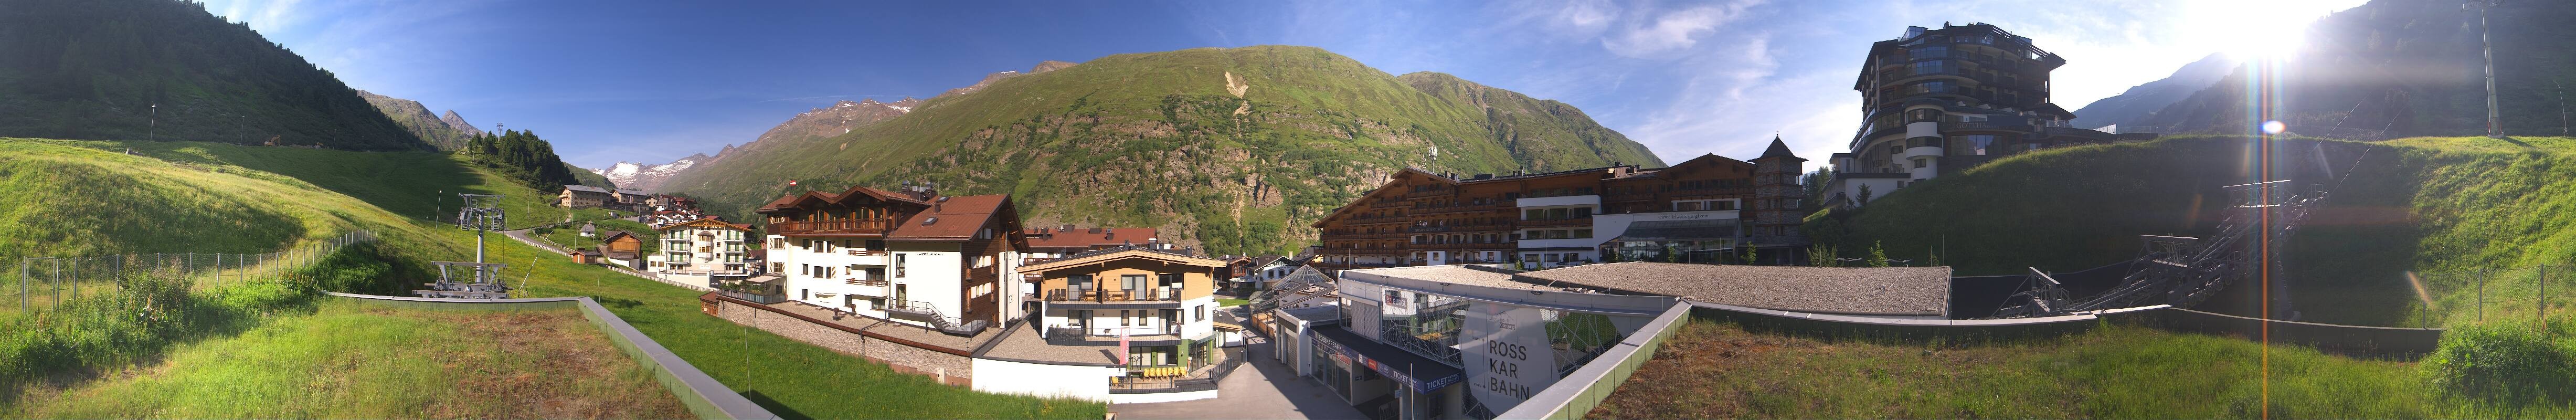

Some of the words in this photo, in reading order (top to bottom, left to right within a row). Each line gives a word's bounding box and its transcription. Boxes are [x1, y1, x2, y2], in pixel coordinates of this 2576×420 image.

[1393, 298, 1407, 307] GURGL
[1319, 334, 1342, 352] ROSSKARBAHN
[1490, 340, 1526, 361] ROSS
[1393, 371, 1409, 383] TICKET
[1490, 358, 1518, 379] KAR
[1427, 376, 1448, 390] TICKET
[1491, 376, 1530, 400] BAHN
